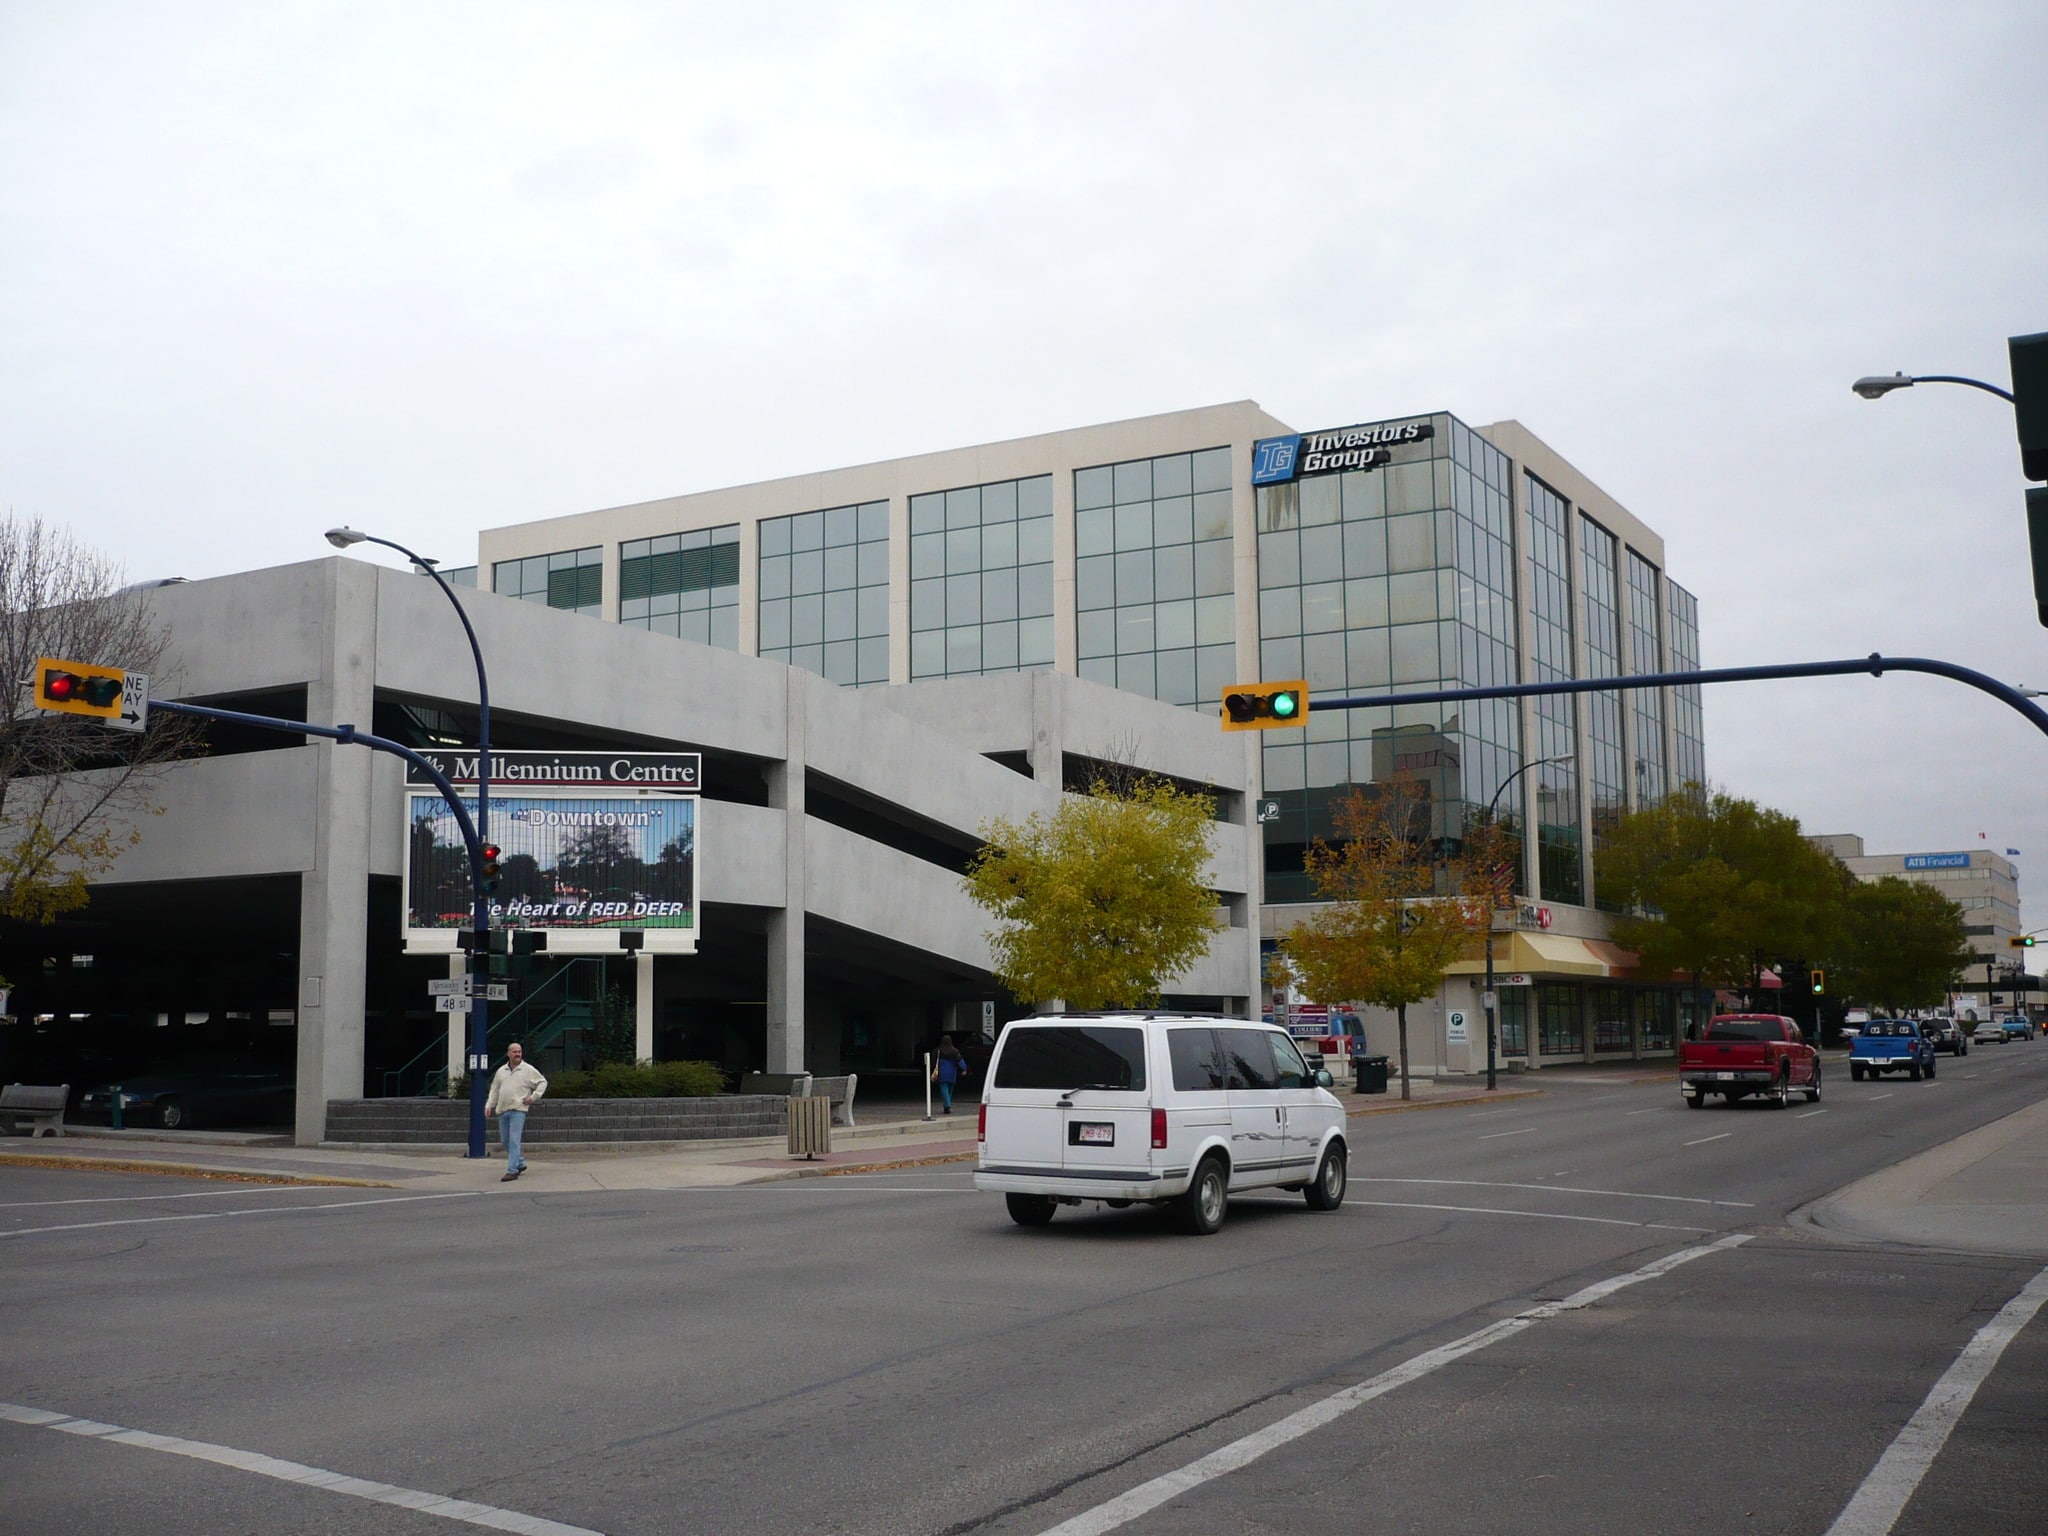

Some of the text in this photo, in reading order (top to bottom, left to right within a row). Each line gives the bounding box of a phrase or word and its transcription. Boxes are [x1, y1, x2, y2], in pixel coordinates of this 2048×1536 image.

[1308, 423, 1419, 453] Investors
[1304, 449, 1375, 472] Group
[125, 676, 143, 691] NE
[124, 693, 143, 706] AY
[452, 757, 603, 782] Mllennium
[610, 759, 695, 783] Centre
[1908, 855, 1964, 867] ATB Financial
[469, 901, 684, 917] Te Heart of RED DEER
[1493, 975, 1511, 984] SBC
[488, 987, 496, 997] 49
[443, 998, 466, 1010] 48 ST
